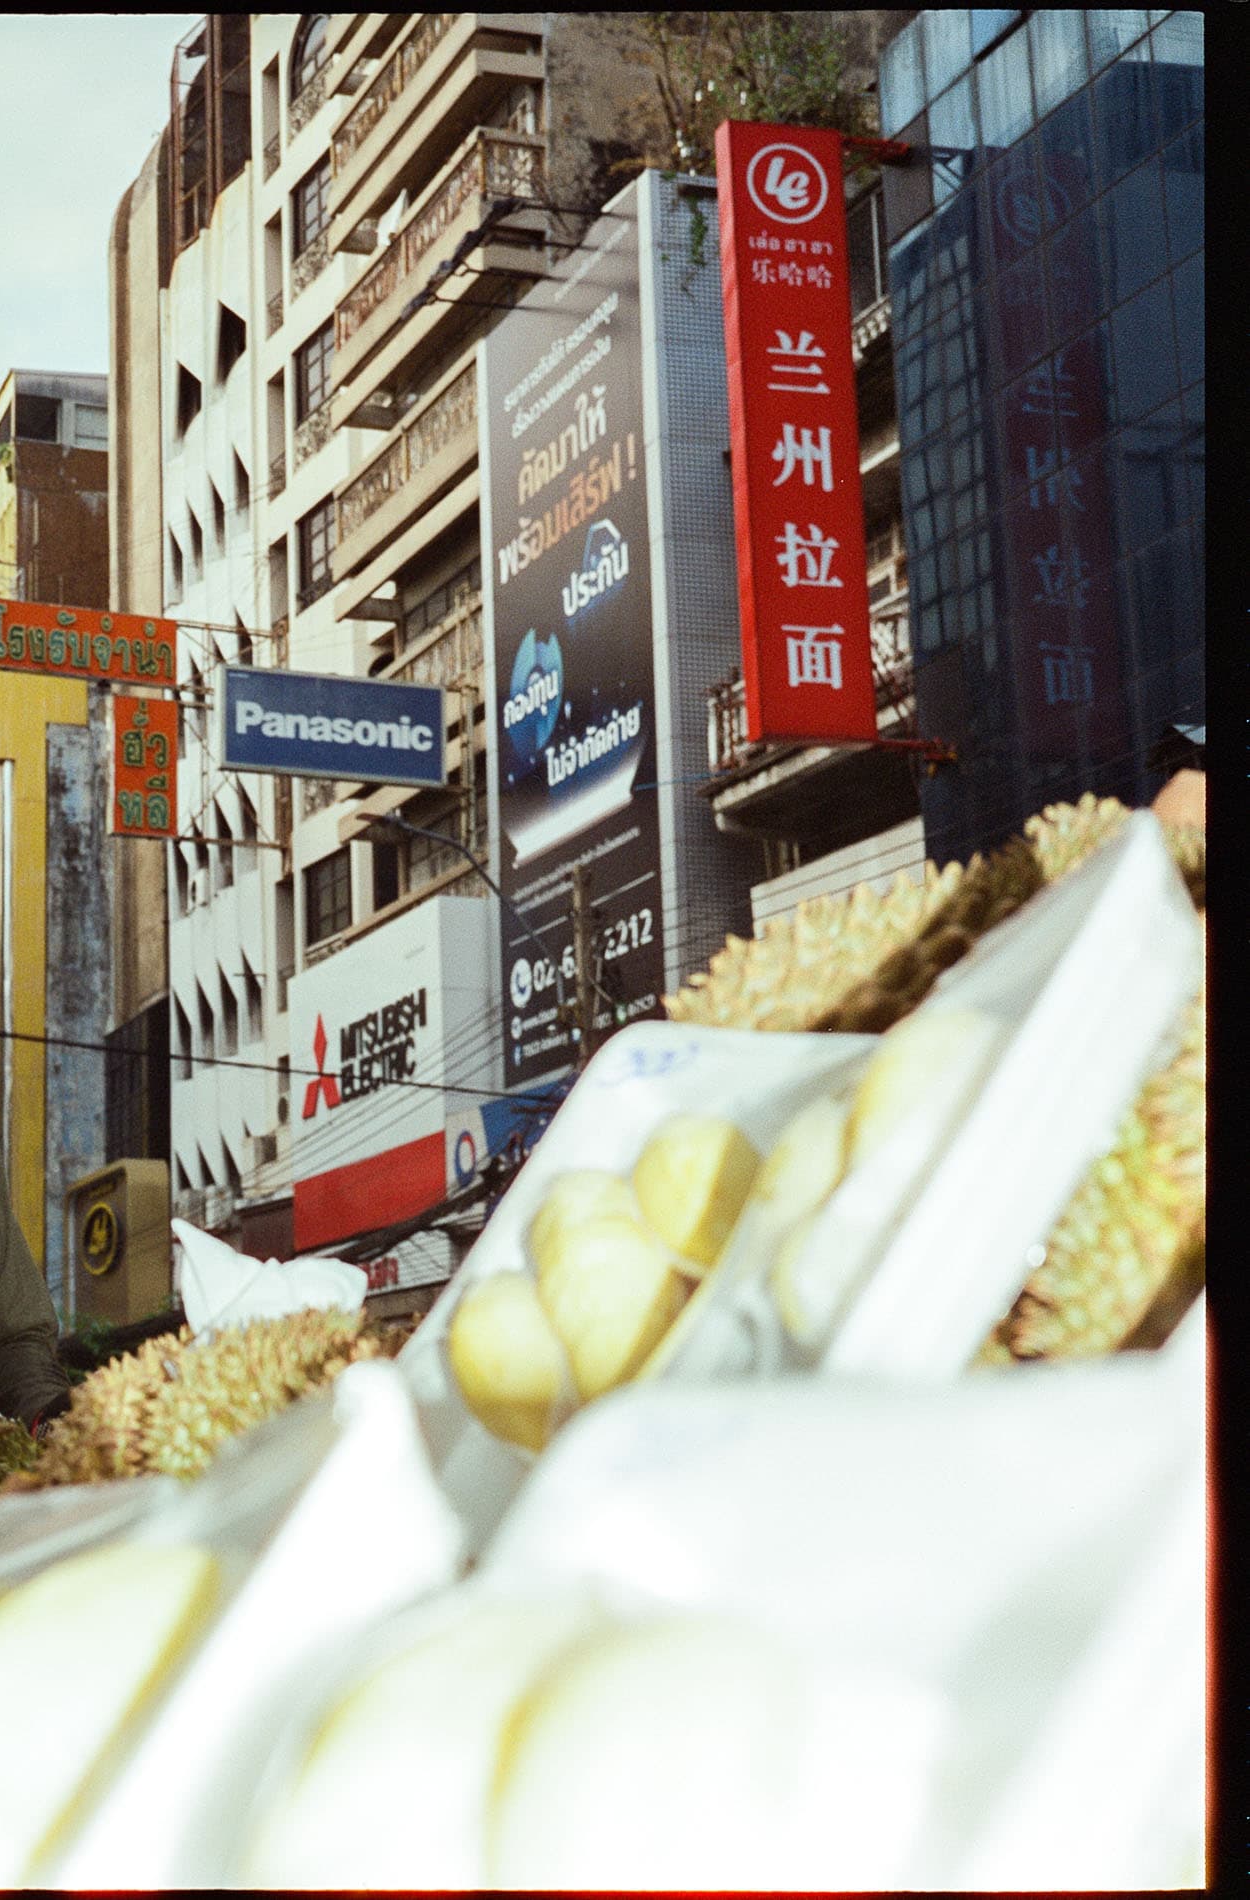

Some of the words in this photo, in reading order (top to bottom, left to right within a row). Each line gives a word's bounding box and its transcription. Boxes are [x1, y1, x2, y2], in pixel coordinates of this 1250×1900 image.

[752, 258, 832, 289] 乐哈哈
[518, 384, 607, 505] คัดมาให้
[766, 330, 845, 690] 兰州拉面
[562, 541, 630, 617] ประกัน
[235, 700, 434, 751] Panasonic
[503, 670, 558, 728] กองทุน
[545, 707, 641, 787] ไม่จำกัดค่าย
[340, 988, 427, 1063] MITSUBISHI
[340, 1036, 417, 1103] ELECTRIC
